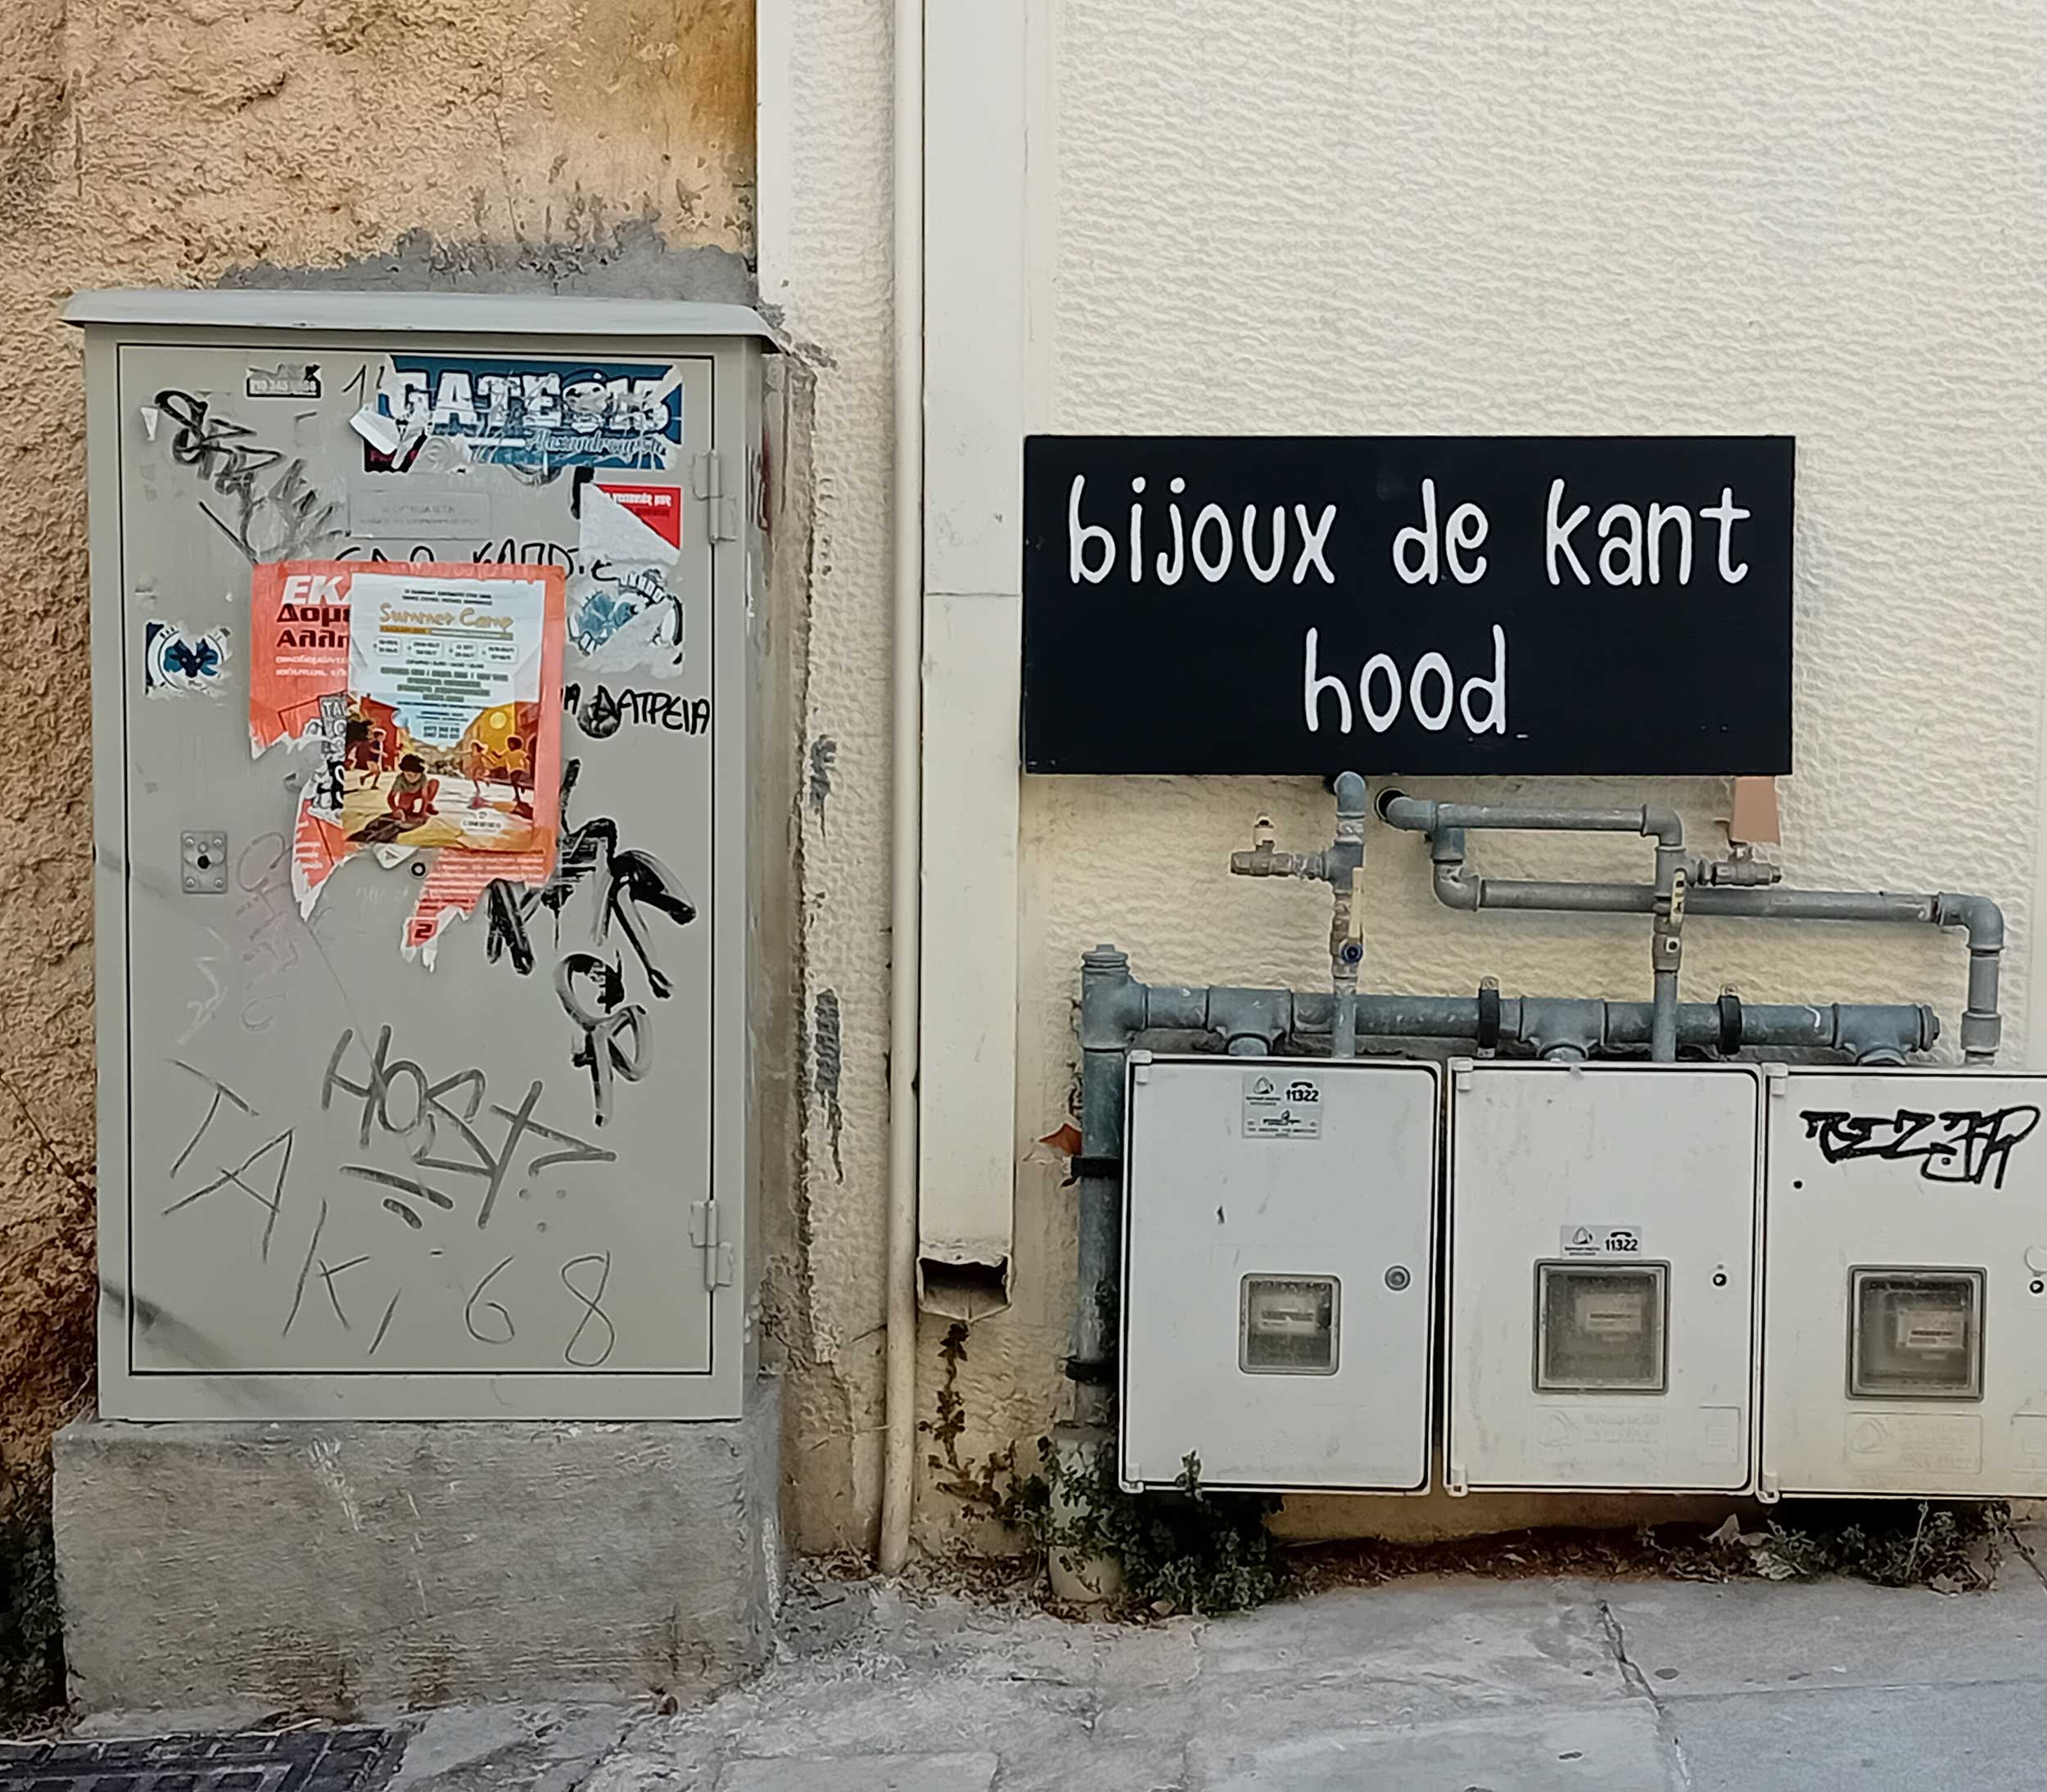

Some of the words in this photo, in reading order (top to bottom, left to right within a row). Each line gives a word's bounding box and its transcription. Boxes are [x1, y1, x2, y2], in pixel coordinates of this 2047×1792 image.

[1069, 475, 1336, 585] bijoux
[1394, 479, 1489, 584] de
[1547, 479, 1750, 585] kant
[380, 602, 455, 625] Summer
[459, 607, 514, 632] Camp
[1305, 625, 1505, 734] hood
[1286, 1089, 1319, 1102] 11322
[1606, 1239, 1638, 1251] 11322
